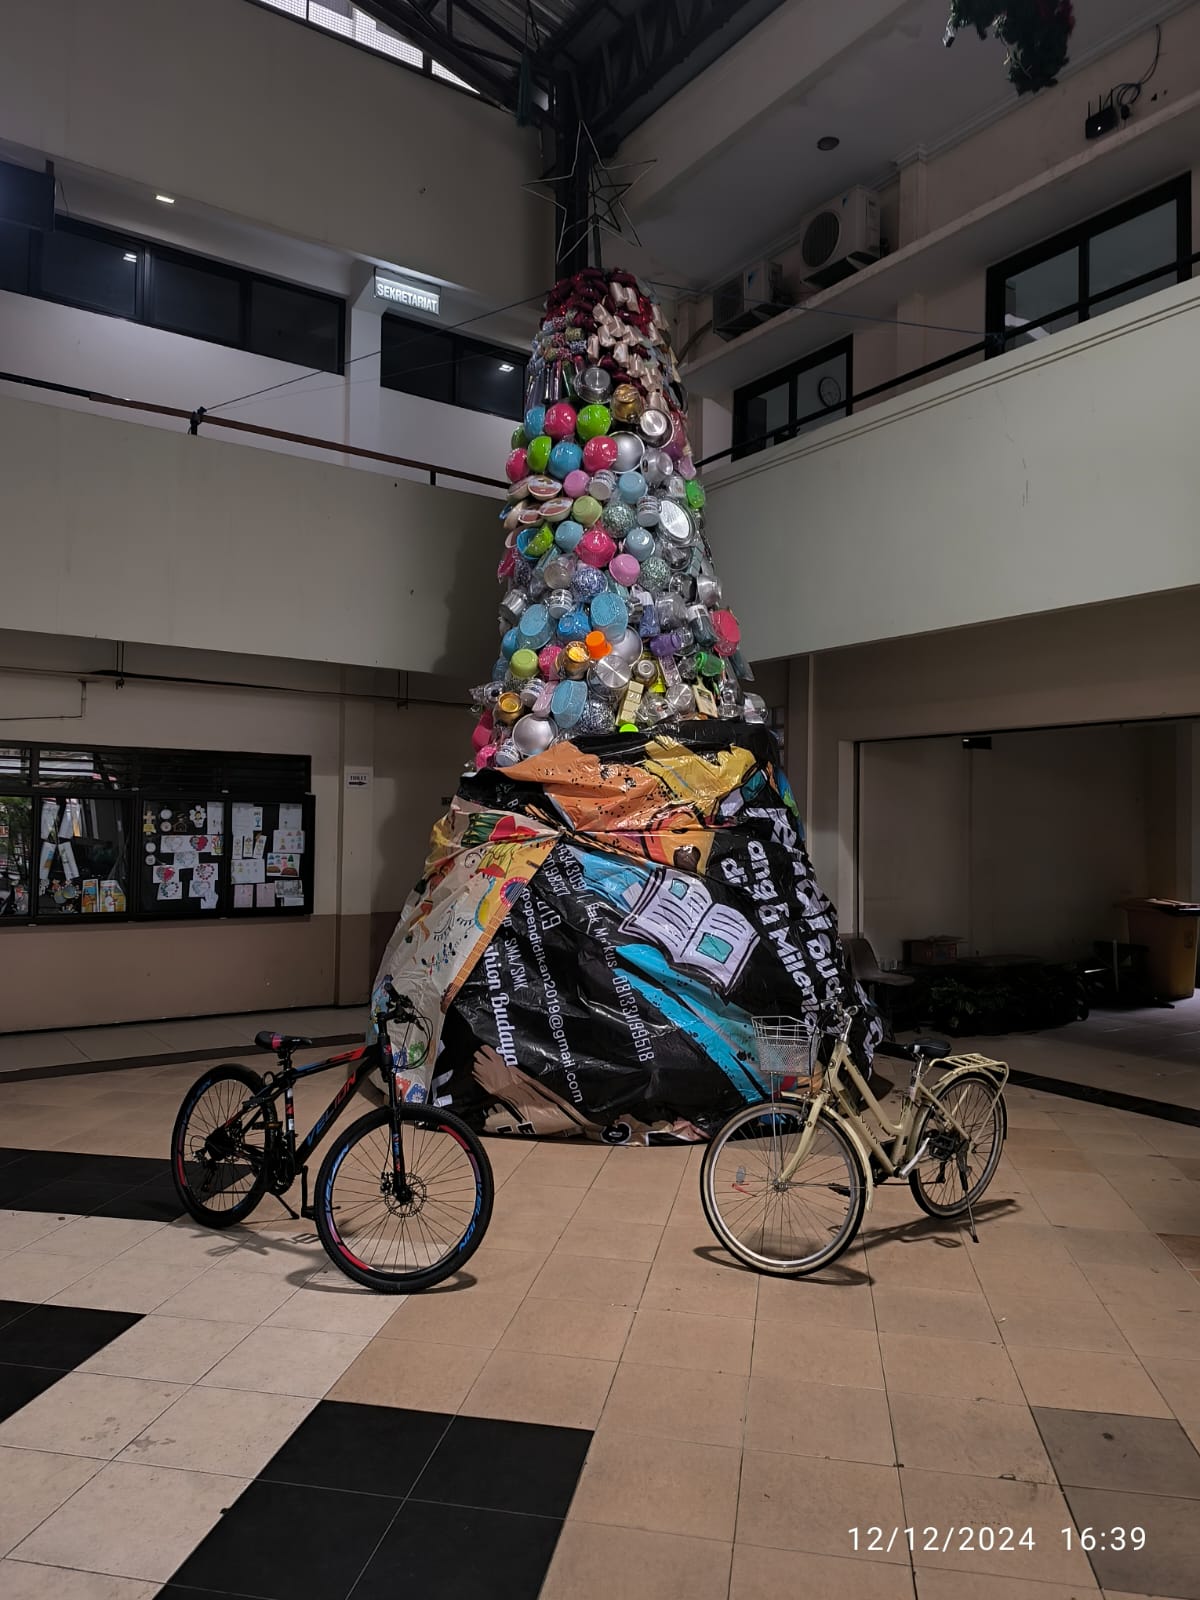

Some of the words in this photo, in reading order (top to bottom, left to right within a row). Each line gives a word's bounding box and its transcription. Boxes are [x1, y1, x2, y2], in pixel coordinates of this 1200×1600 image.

[377, 283, 437, 312] SEKRETARIAT
[504, 937, 529, 991] SMA/SMK
[491, 992, 518, 1067] Budaya
